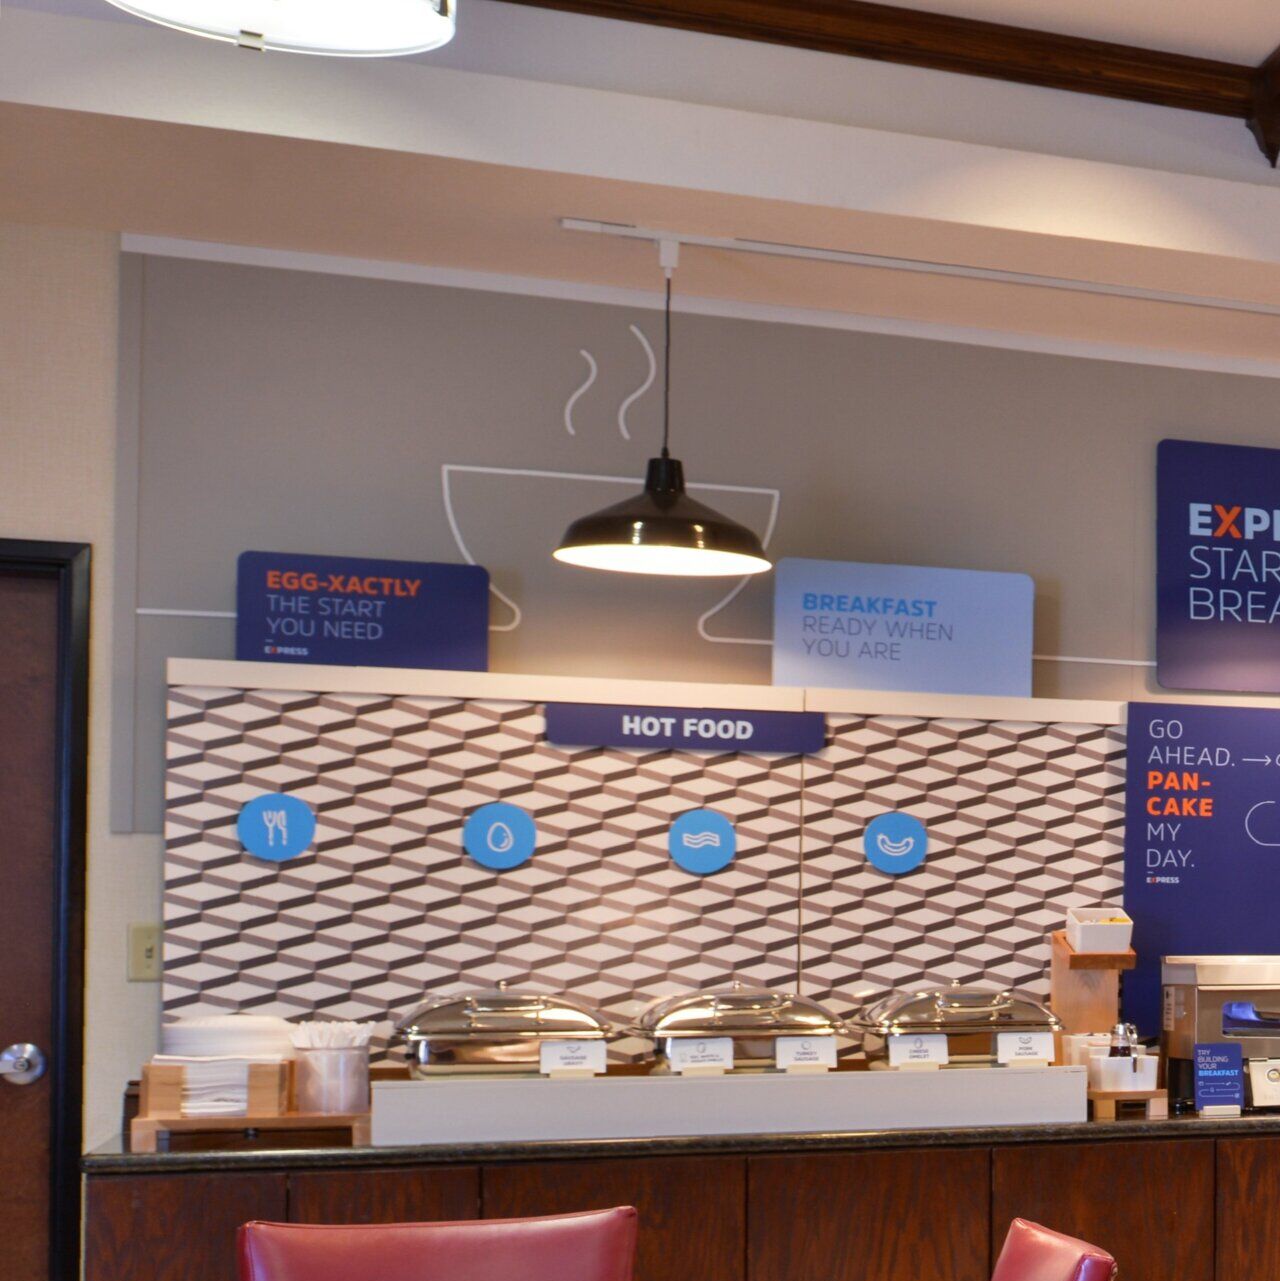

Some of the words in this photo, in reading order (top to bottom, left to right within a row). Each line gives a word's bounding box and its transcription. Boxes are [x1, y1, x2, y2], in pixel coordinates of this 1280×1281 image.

[266, 570, 421, 596] EGG-XACTLY
[266, 594, 310, 614] THE
[318, 597, 385, 617] START
[802, 592, 937, 617] BREAKFAST
[266, 617, 315, 637] YOU
[324, 621, 383, 640] NEED
[803, 615, 877, 636] READY
[885, 621, 953, 641] WHEN
[264, 646, 308, 656] EXPRESS
[803, 638, 850, 658] YOU
[858, 641, 902, 661] ARE
[622, 715, 676, 737] HOT
[683, 718, 753, 740] FOOD
[1149, 719, 1183, 739] GO
[1148, 745, 1235, 767] AHEAD.
[1147, 771, 1211, 791] PAN-
[1146, 797, 1213, 817] CAKE
[1147, 823, 1181, 842] MY
[1146, 848, 1195, 868] DAY.
[1146, 876, 1180, 884] EXPRESS
